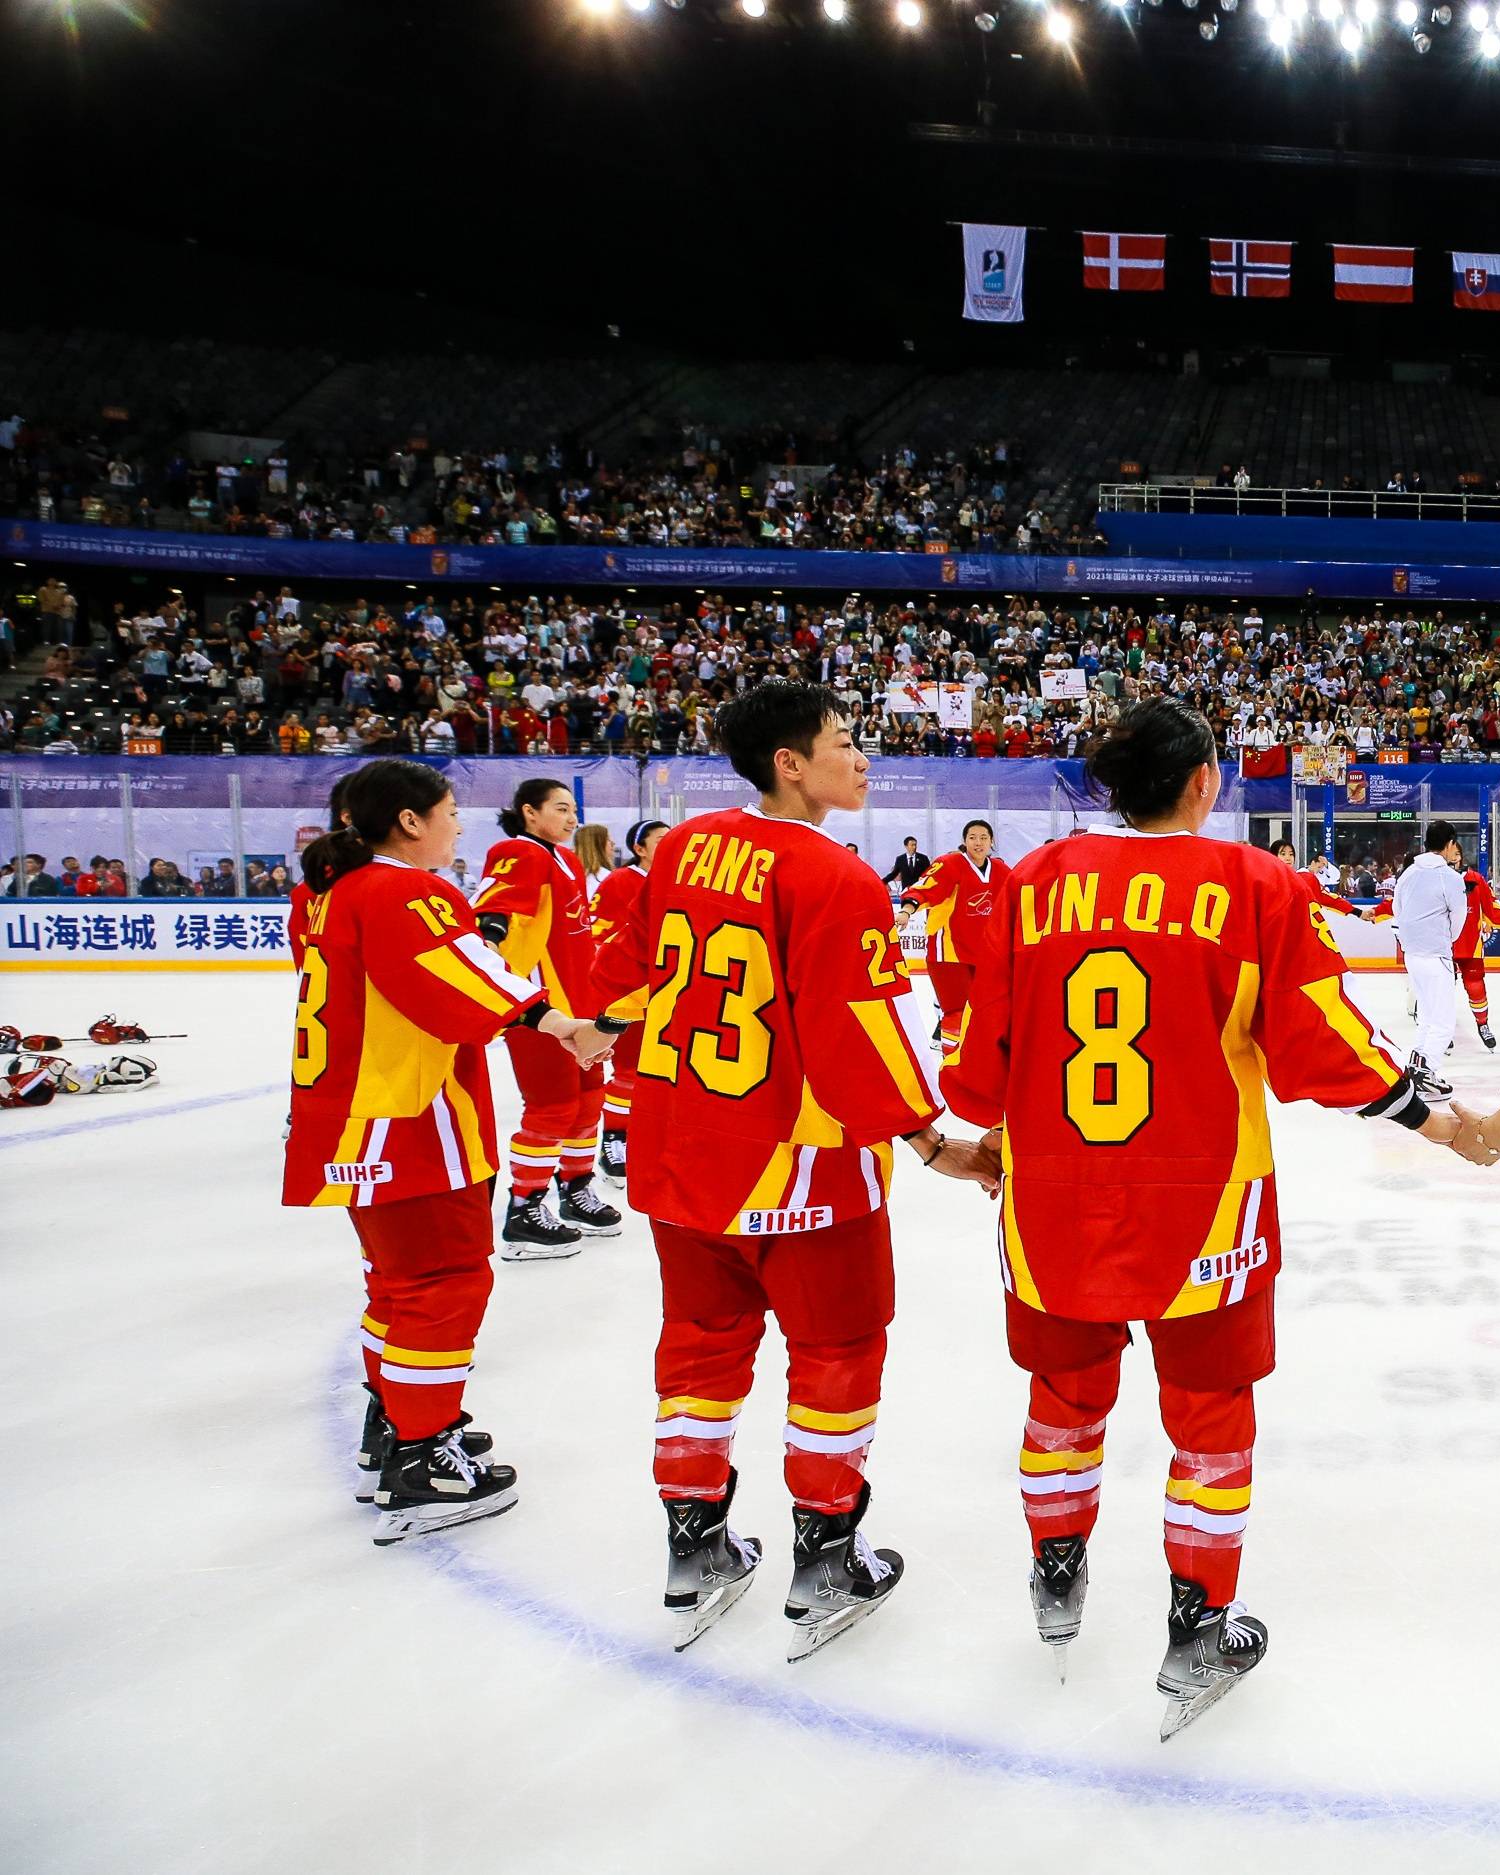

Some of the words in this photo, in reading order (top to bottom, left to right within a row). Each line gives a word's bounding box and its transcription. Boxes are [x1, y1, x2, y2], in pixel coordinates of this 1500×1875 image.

[133, 743, 157, 754] 118
[1384, 755, 1404, 764] 116
[675, 832, 775, 903] FANG
[6, 914, 156, 951] 山海连城
[174, 914, 291, 951] 绿美深
[1308, 901, 1341, 954] 8
[637, 910, 776, 1101] 23
[1061, 945, 1155, 1147] 8
[339, 1163, 384, 1183] IIHF
[767, 1206, 825, 1230] IIHF
[1215, 1245, 1262, 1278] IIHF
